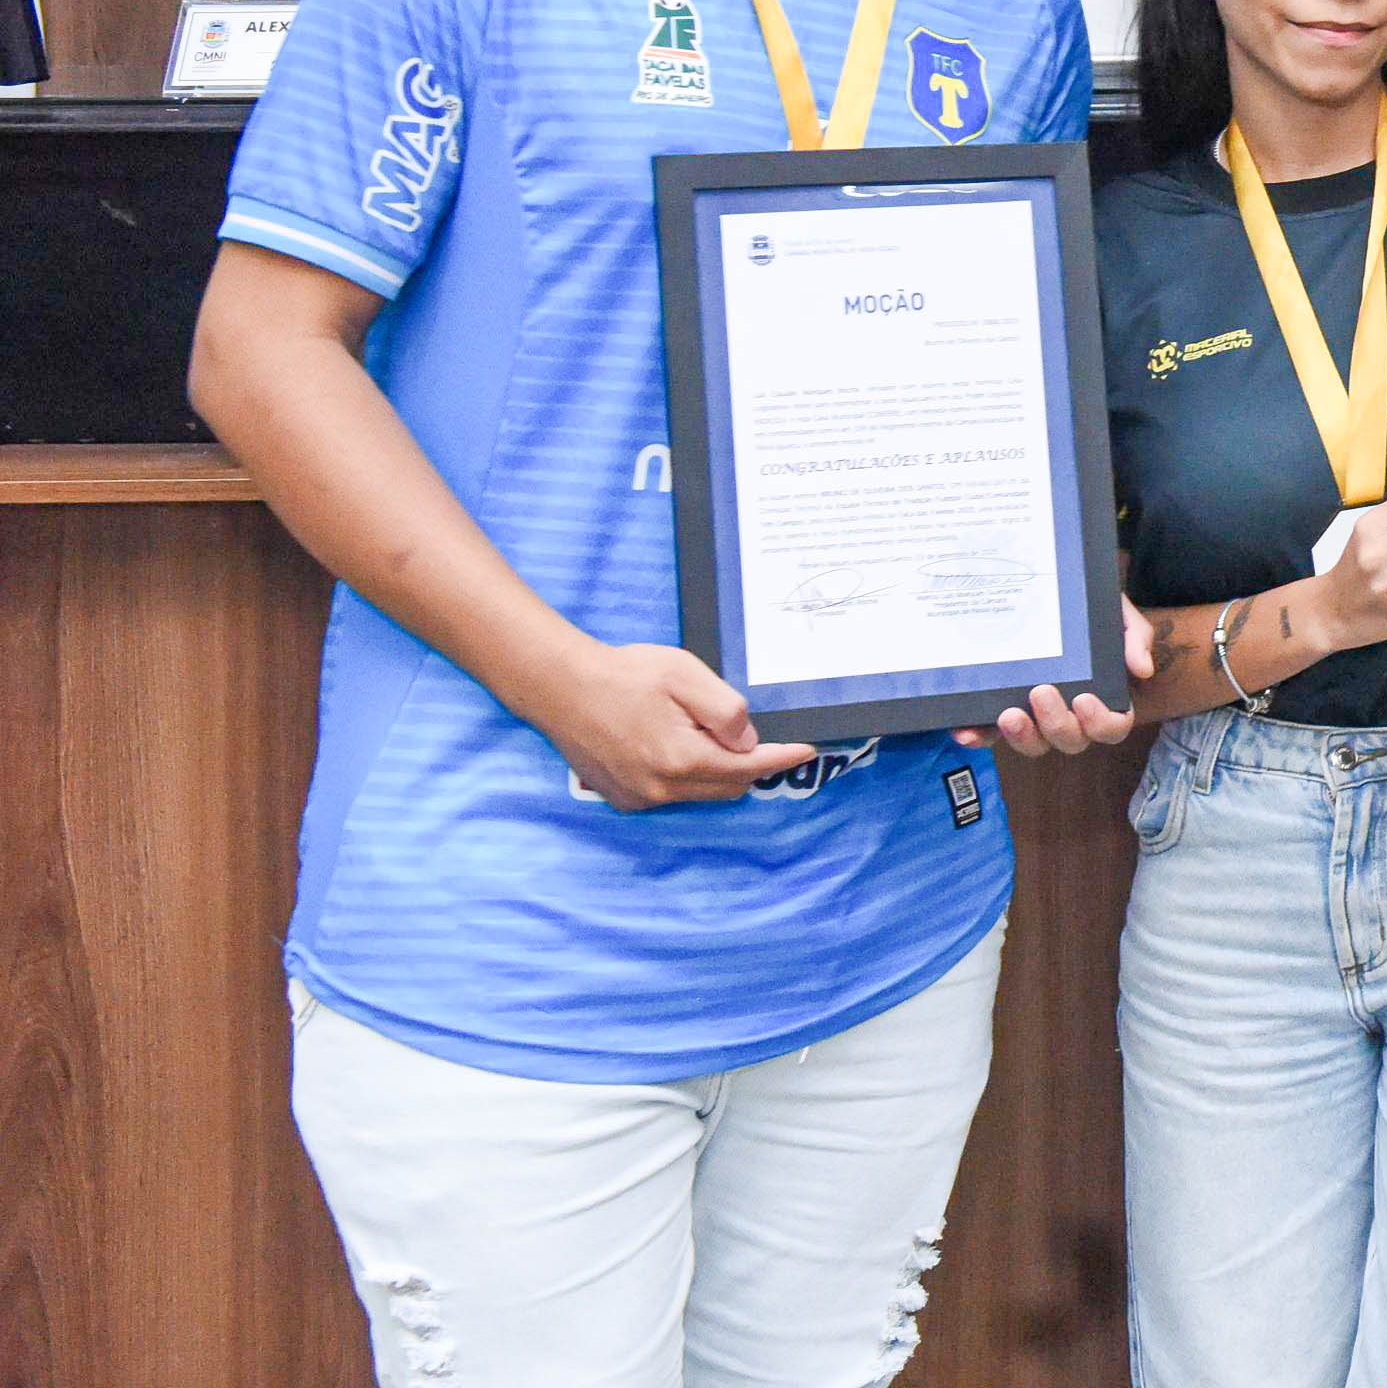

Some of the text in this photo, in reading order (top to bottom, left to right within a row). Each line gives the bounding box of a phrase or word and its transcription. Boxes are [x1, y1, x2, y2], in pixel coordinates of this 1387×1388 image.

[930, 53, 964, 77] TFC
[844, 288, 925, 316] MOÇÃO
[759, 445, 1026, 478] CONGRATULAÇÕES E APLAUSOS
